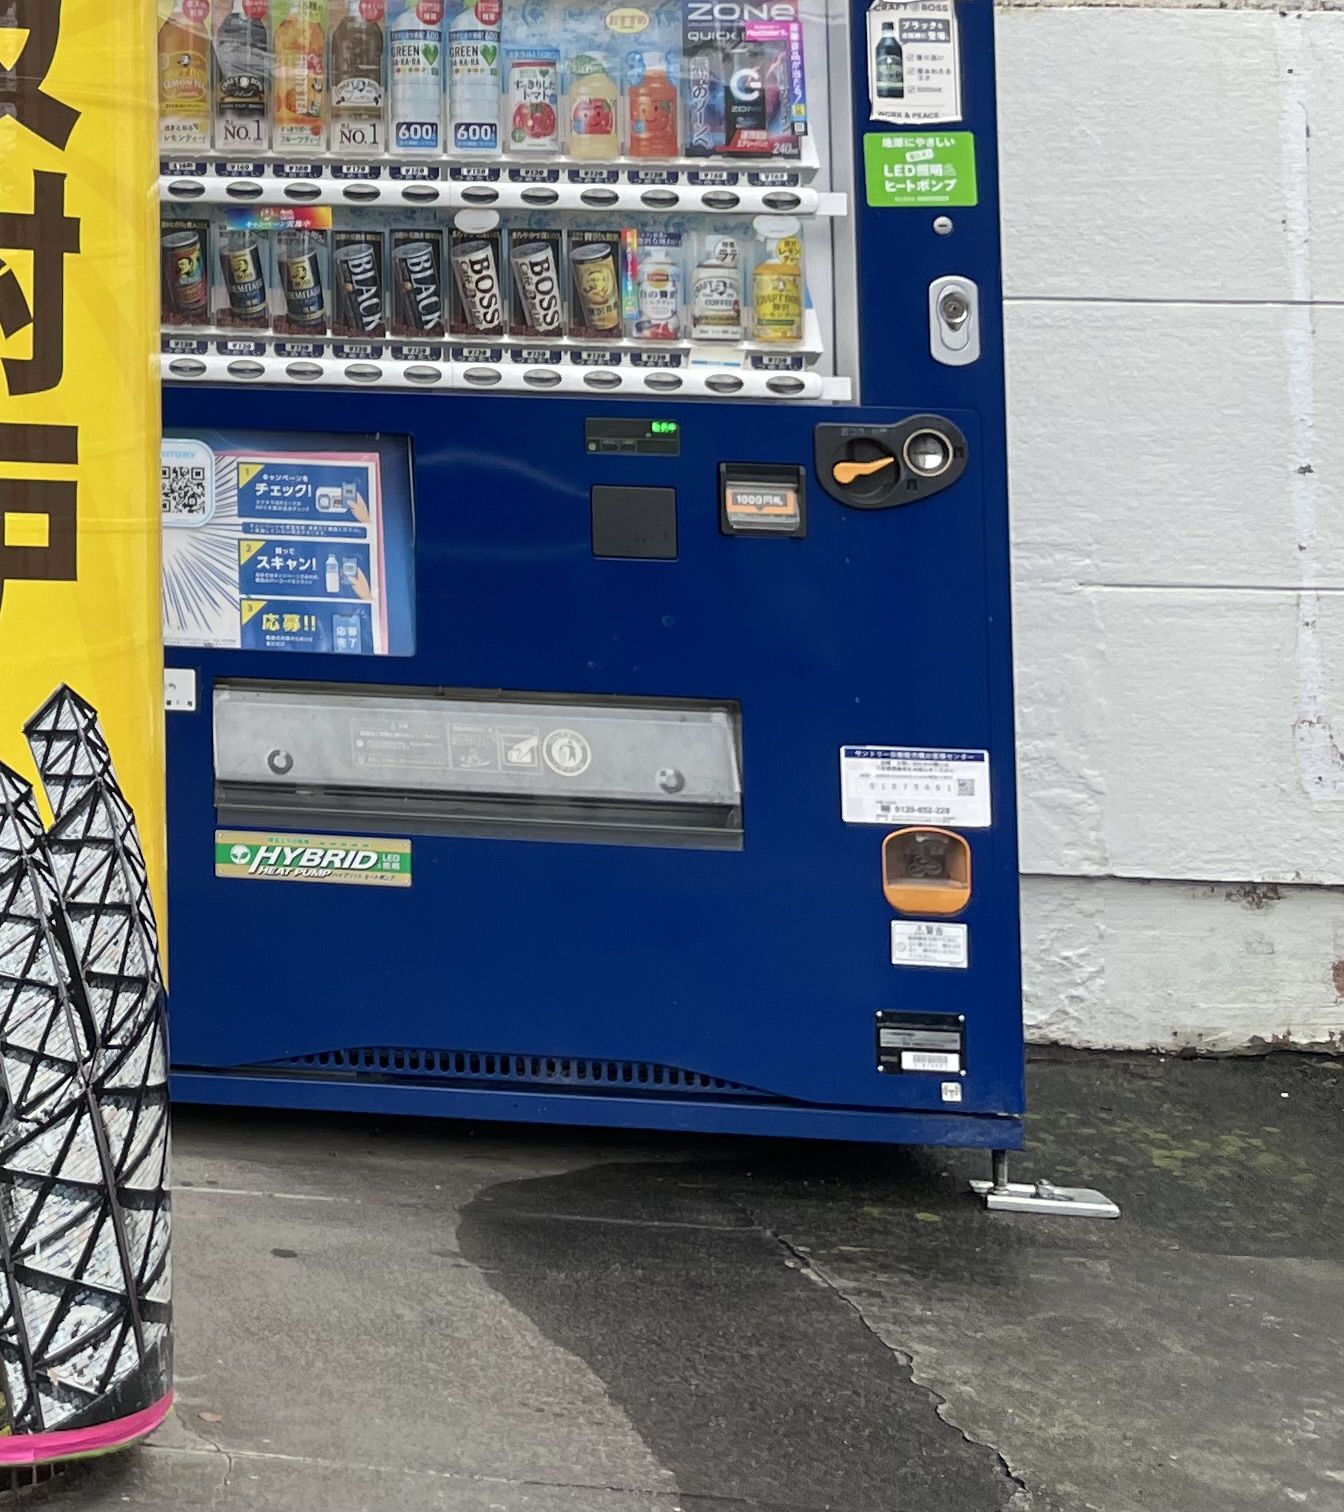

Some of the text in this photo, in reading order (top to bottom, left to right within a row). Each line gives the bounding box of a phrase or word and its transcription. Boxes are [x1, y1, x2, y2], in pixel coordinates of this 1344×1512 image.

[921, 3, 949, 12] BOSS
[687, 31, 737, 42] QUICK
[391, 44, 420, 57] GREEN
[450, 44, 479, 57] GREEN
[339, 123, 378, 145] NO.1
[884, 178, 957, 193] ヒートポンプ
[346, 253, 383, 332] BLACK
[405, 252, 442, 331] BLACK
[468, 255, 502, 328] BOSS
[528, 252, 560, 329] BOSS
[255, 483, 312, 498] チェック!
[256, 556, 317, 571] スキャン!
[248, 845, 379, 875] HYBRID
[382, 853, 400, 862] LED
[257, 866, 332, 879] HEAT PUMP
